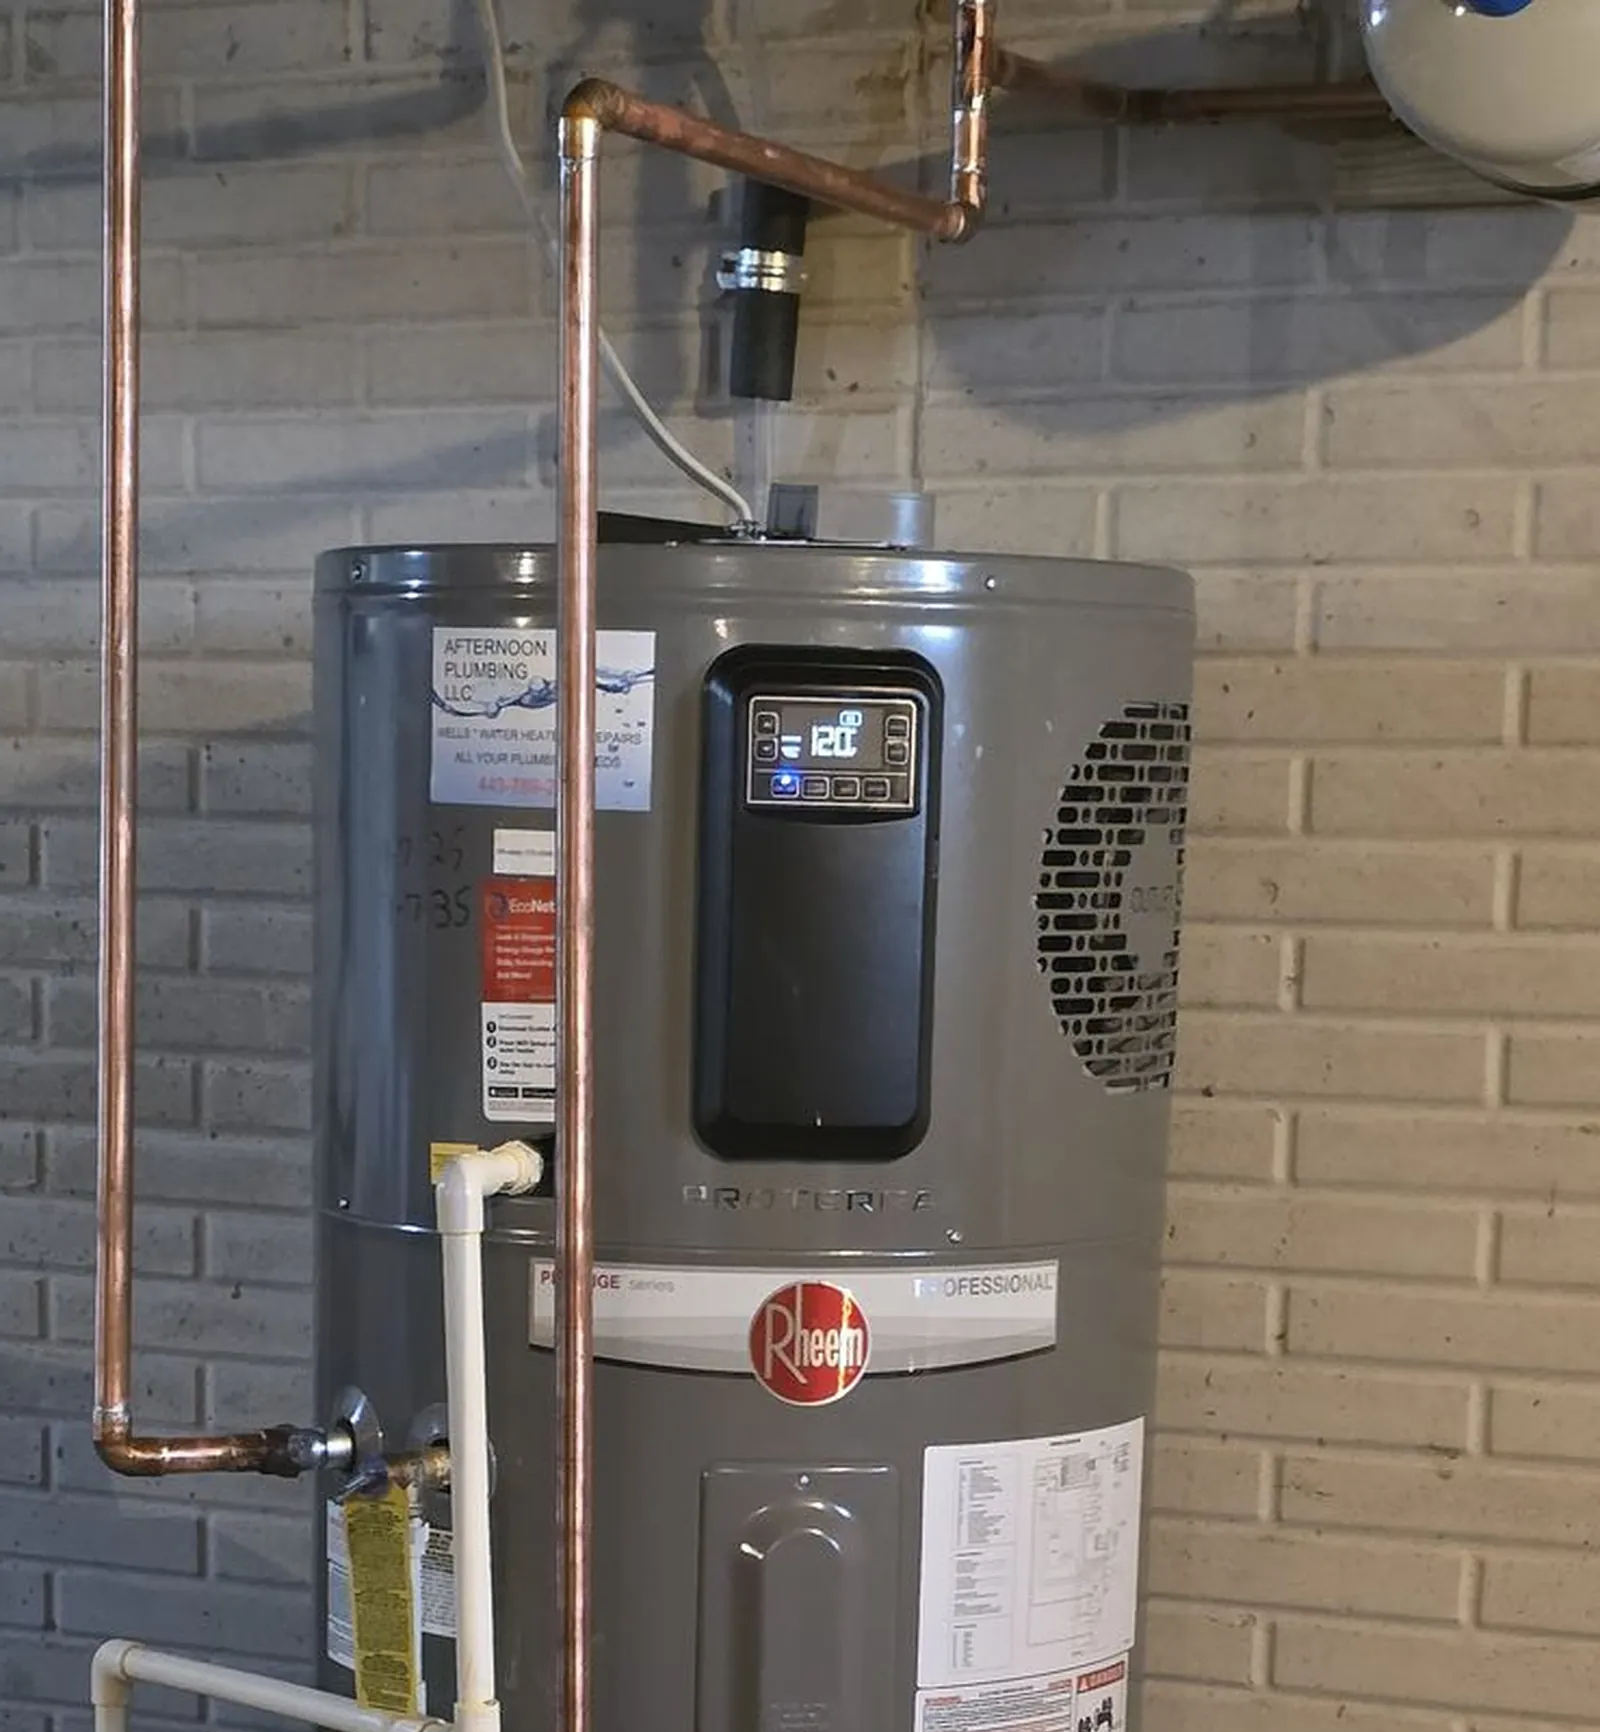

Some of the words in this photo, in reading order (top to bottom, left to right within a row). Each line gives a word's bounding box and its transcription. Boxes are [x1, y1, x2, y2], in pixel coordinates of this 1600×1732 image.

[444, 638, 547, 656] AFTERNOON
[444, 662, 529, 680] PLUMBING
[444, 685, 472, 701] LLC
[480, 727, 518, 741] WATER
[595, 731, 642, 746] EPAIRS
[454, 751, 473, 764] ALL
[476, 751, 508, 765] YOUR
[595, 754, 621, 769] EDS
[508, 898, 556, 914] EcoNet
[629, 1279, 677, 1294] series
[913, 1272, 1053, 1298] OFESSIONAL
[764, 1283, 864, 1385] Rheem
